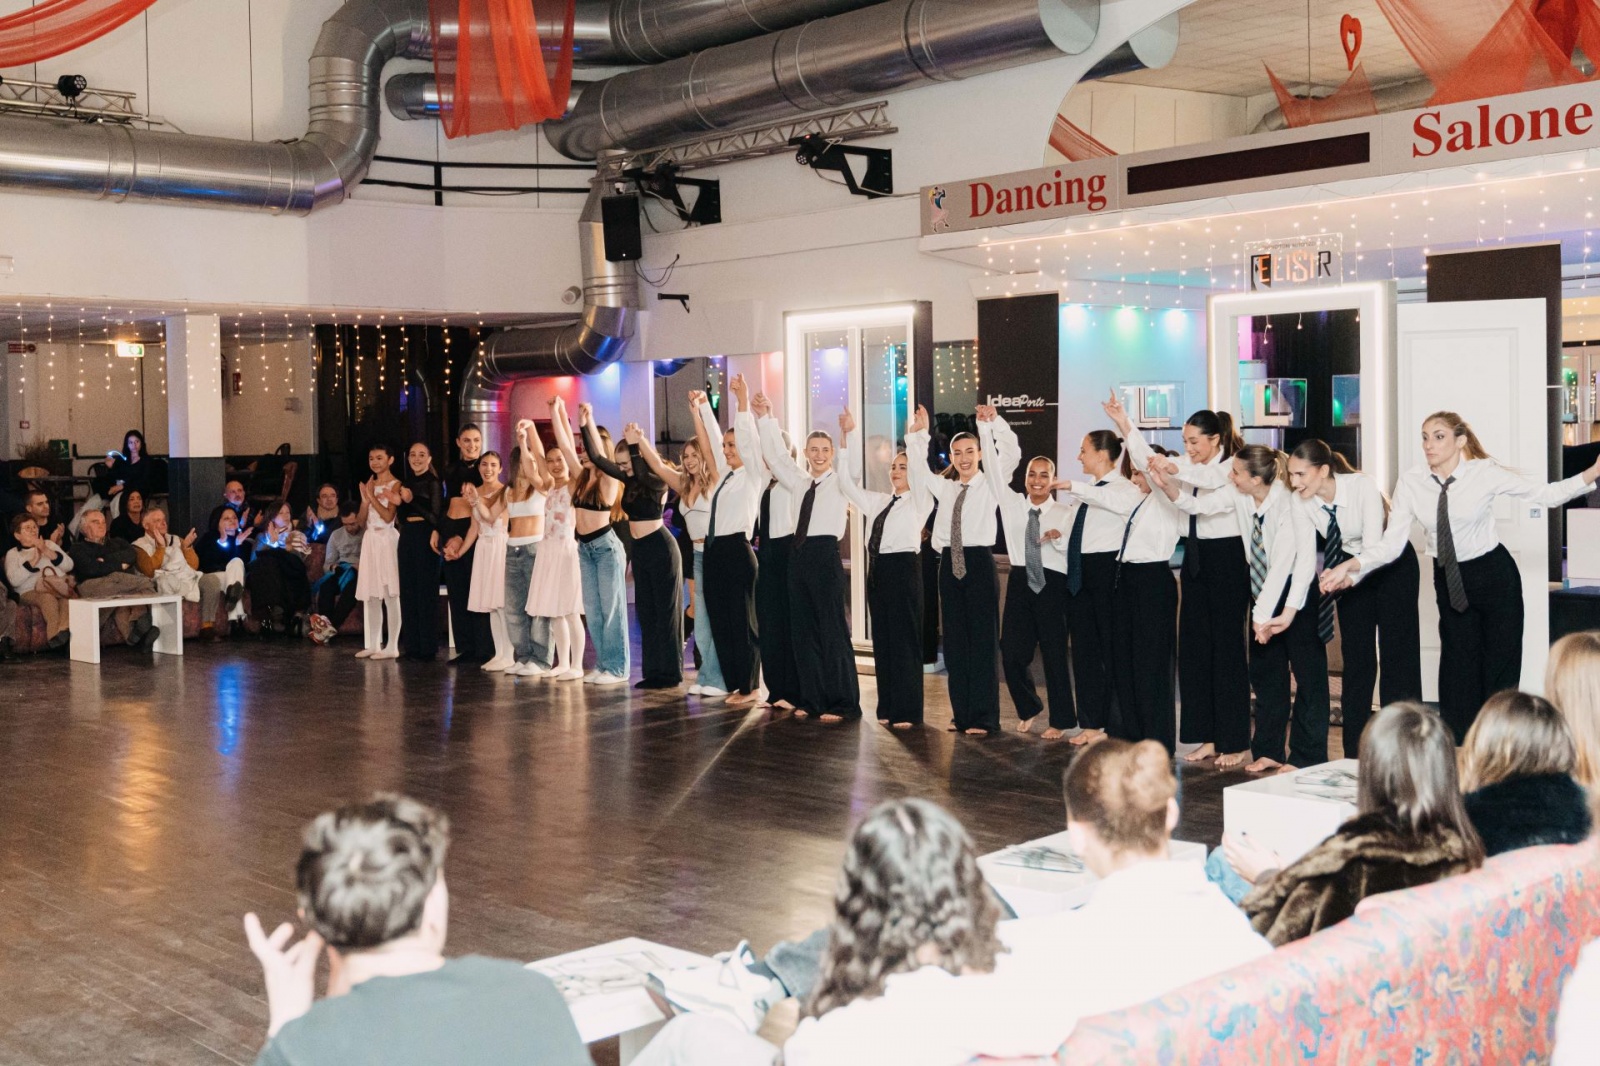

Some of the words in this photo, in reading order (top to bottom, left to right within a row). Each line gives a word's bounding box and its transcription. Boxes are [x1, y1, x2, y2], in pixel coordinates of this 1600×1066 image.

[1412, 102, 1593, 158] Salone
[968, 169, 1107, 218] Dancing
[1258, 249, 1331, 283] ELISIR
